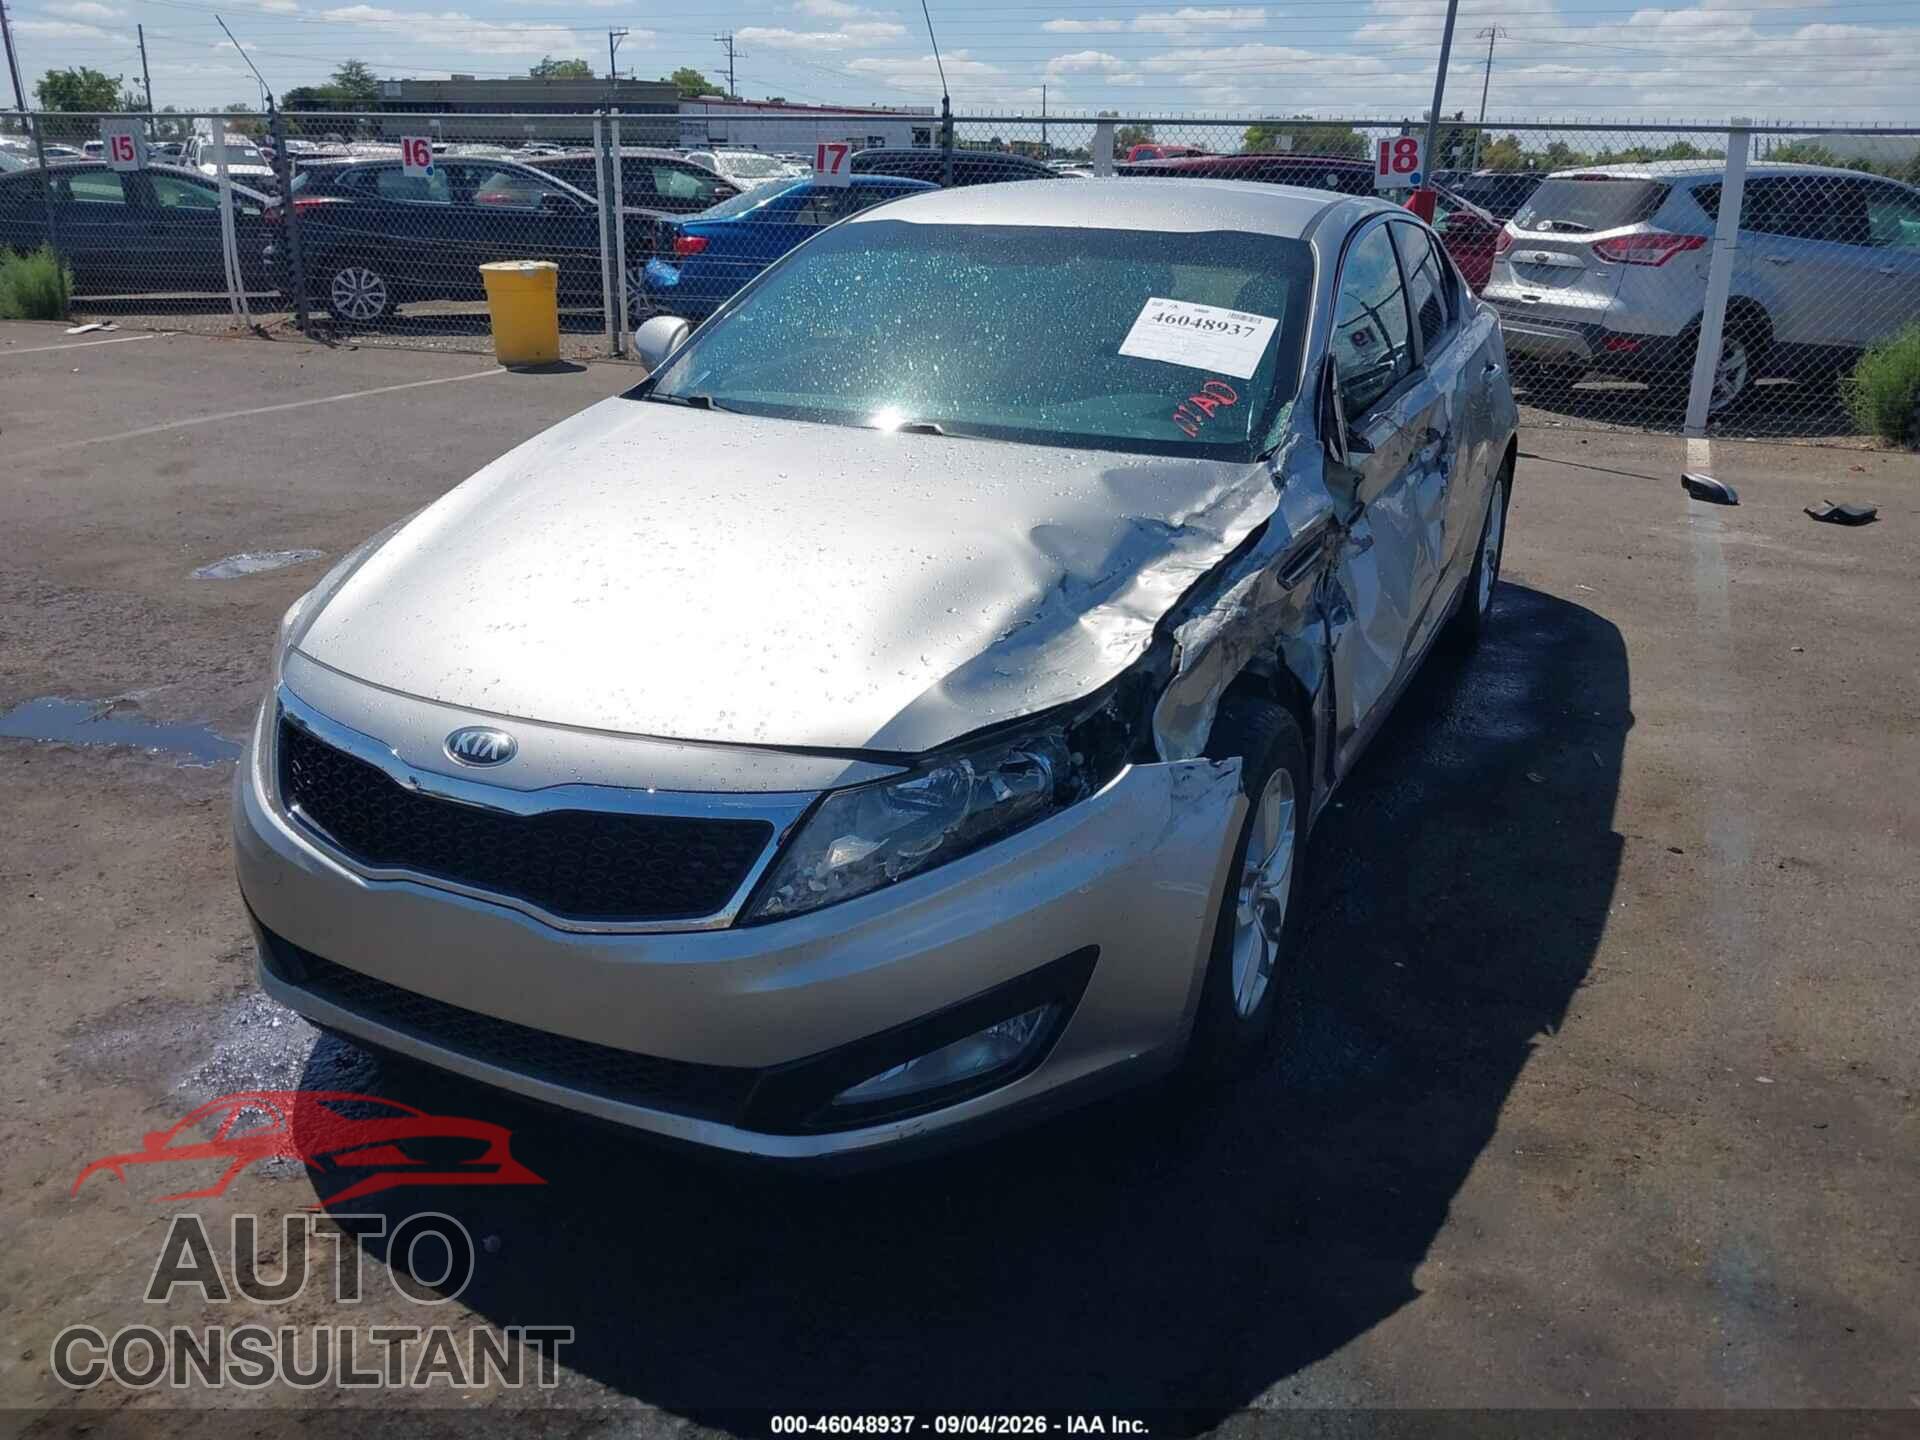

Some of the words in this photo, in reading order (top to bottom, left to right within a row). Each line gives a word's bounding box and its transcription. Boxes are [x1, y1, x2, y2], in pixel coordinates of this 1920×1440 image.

[112, 136, 134, 161] 15
[404, 139, 430, 167] 16
[817, 144, 848, 174] 17
[1380, 139, 1418, 175] 18
[1151, 311, 1255, 338] 46048937
[454, 731, 499, 760] KIA
